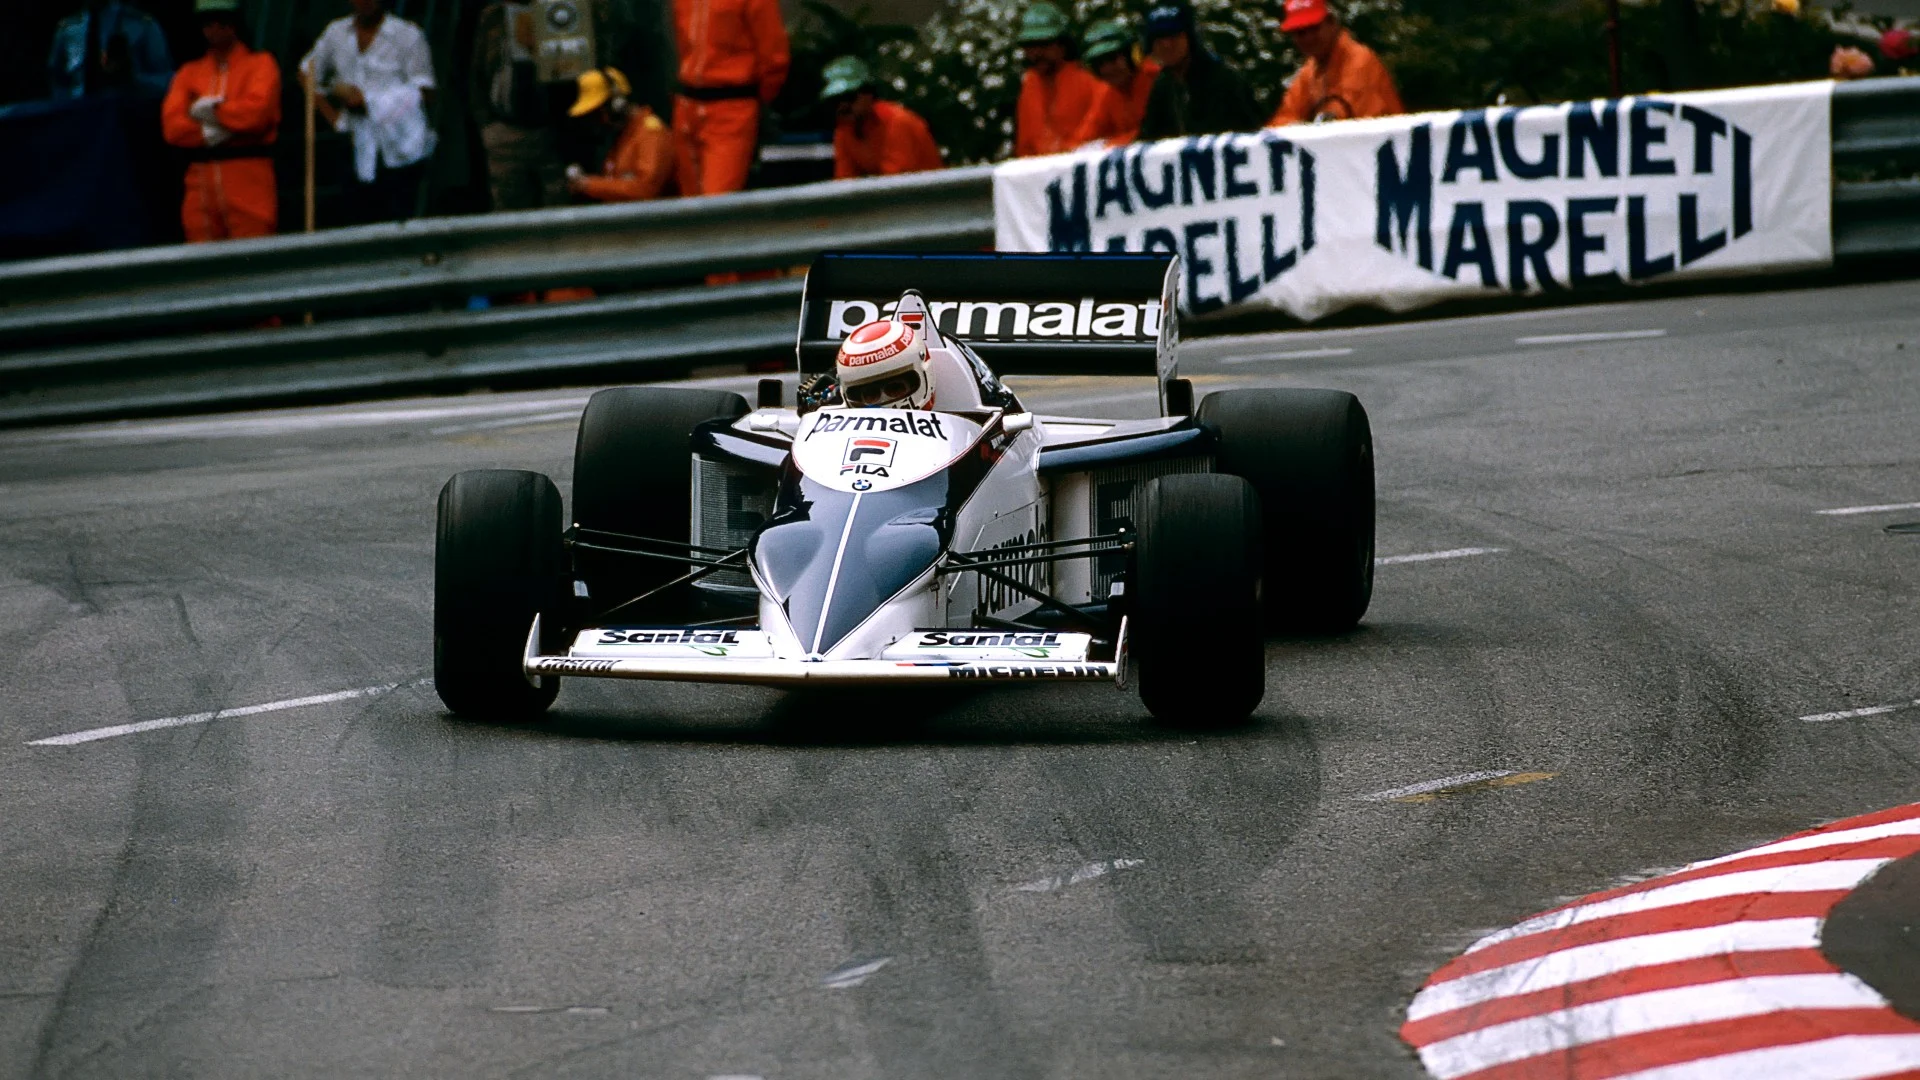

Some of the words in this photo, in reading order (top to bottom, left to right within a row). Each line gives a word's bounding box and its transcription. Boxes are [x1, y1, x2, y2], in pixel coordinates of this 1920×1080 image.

[1045, 132, 1315, 222] MAGNETI
[1377, 97, 1752, 215] MAGNETI
[1045, 195, 1315, 313] MELLI
[1377, 172, 1752, 293] MARELLI
[849, 343, 900, 367] parmalat
[804, 411, 949, 441] parmalat
[839, 464, 890, 478] FILA
[948, 665, 1109, 679] MICHELIN
